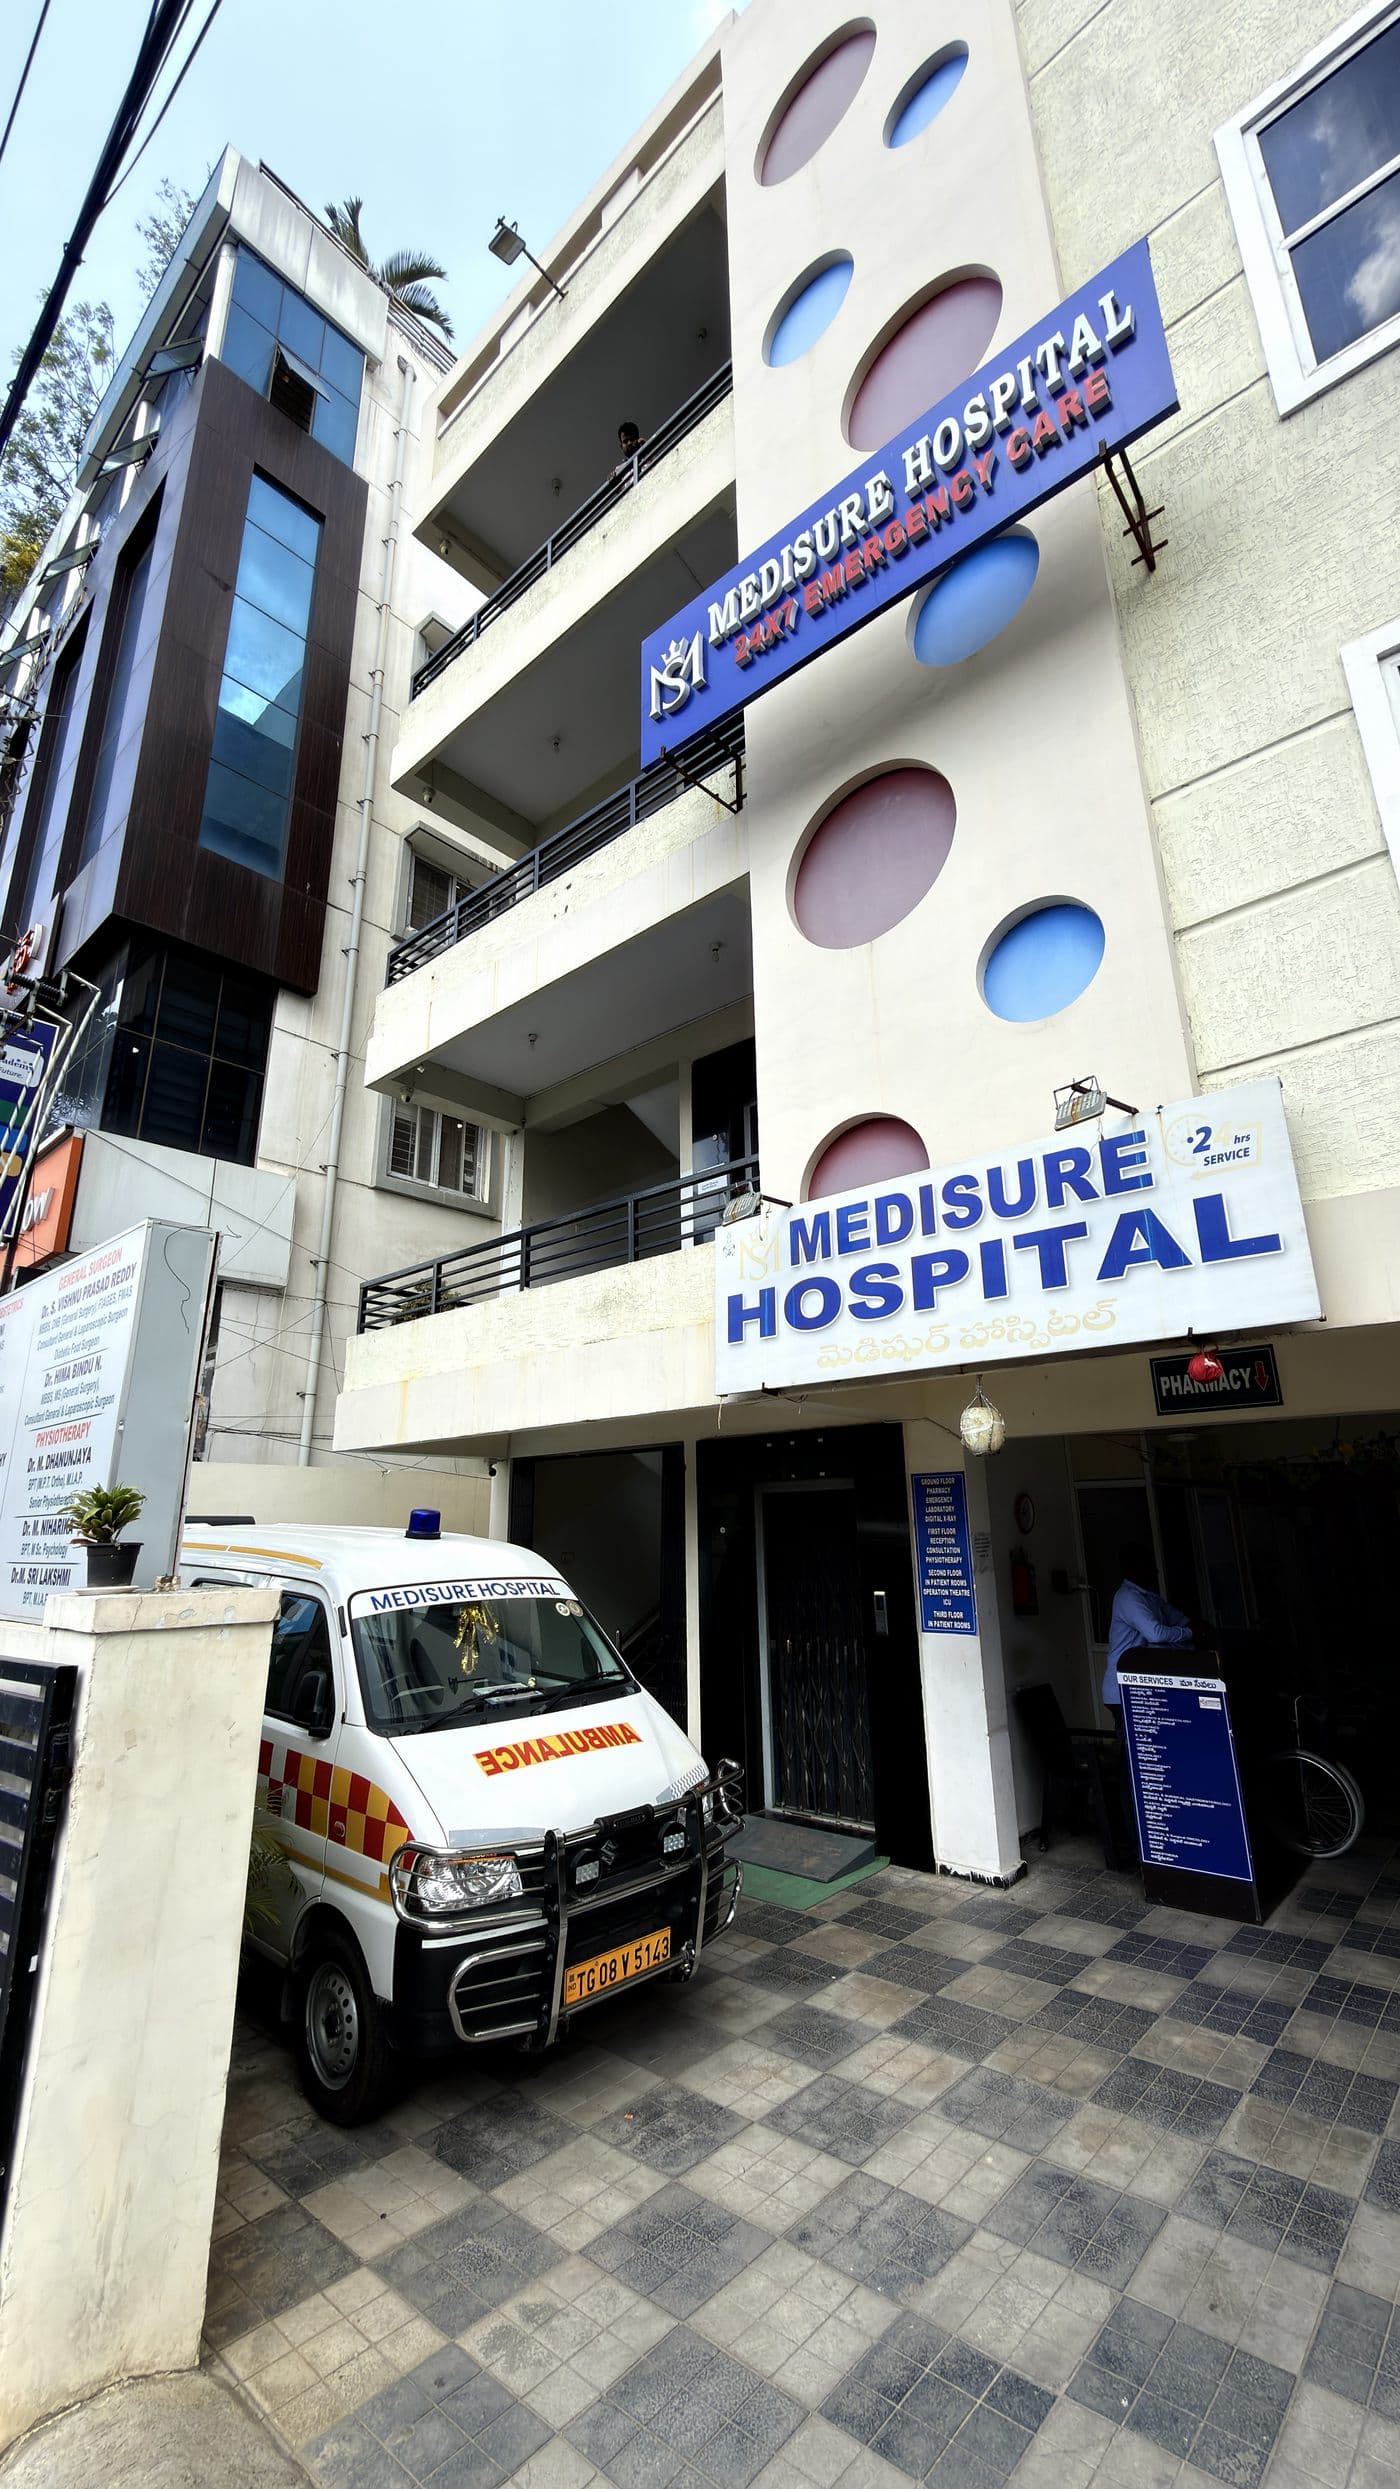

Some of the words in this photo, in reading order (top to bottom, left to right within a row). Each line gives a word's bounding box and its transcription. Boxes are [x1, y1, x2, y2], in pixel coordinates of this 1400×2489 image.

[707, 471, 897, 648] MEDISURE
[902, 288, 1137, 498] HOSPITAL
[732, 598, 803, 670] 24X7
[803, 452, 998, 619] EMERGENCY
[1005, 367, 1114, 473] CARE
[0, 1056, 34, 1077] ademy
[1234, 1133, 1251, 1145] hrs
[1203, 1147, 1250, 1167] SERVICE
[788, 1129, 1154, 1267] MEDISURE
[58, 1265, 88, 1292] GENERAL
[88, 1248, 123, 1278] SURGEON
[727, 1192, 1283, 1344] HOSPITAL
[41, 1305, 50, 1319] Dr.
[58, 1287, 82, 1312] VISHNU
[82, 1274, 109, 1300] PRASAD
[111, 1262, 138, 1288] REDDY
[107, 1307, 129, 1324] Surgeon
[81, 1335, 101, 1353] Surgeon
[44, 1372, 53, 1387] Dr.
[54, 1365, 71, 1384] HIMA
[71, 1358, 95, 1379] BINDU
[94, 1355, 103, 1371] N.
[24, 1408, 45, 1426] Consultant
[45, 1405, 60, 1421] General
[64, 1398, 94, 1418] Laparoscopic
[95, 1393, 116, 1410] Surgeon
[35, 1421, 91, 1449] PHYSIOTHERAPY
[27, 1457, 35, 1473] Dr.
[36, 1454, 44, 1471] M.
[45, 1446, 92, 1470] DHANUNJAYA
[921, 1478, 940, 1486] GROUND
[940, 1477, 956, 1485] FLOOR
[926, 1487, 951, 1495] PHARMACY
[29, 1496, 42, 1509] Senior
[925, 1496, 953, 1504] EMERGENCY
[925, 1505, 955, 1513] LABORATORY
[925, 1515, 943, 1523] DIGITAL
[22, 1520, 31, 1537] Dr.
[32, 1519, 39, 1536] M.
[941, 1527, 957, 1535] FLOOR
[930, 1537, 956, 1545] RECEPTION
[43, 1541, 68, 1559] Psychology
[926, 1546, 961, 1554] CONSULTATION
[925, 1556, 963, 1564] PHYSIOTHERAPY
[26, 1567, 39, 1585] SRI
[39, 1568, 71, 1587] LAKSHMI
[928, 1569, 946, 1577] SECOND
[947, 1569, 963, 1577] FLOOR
[370, 1584, 478, 1611] MEDISURE
[478, 1582, 561, 1598] HOSPITAL
[923, 1588, 949, 1596] OPERATION
[950, 1589, 971, 1597] THEATRE
[943, 1598, 952, 1606] ICU
[933, 1610, 948, 1618] THIRD
[948, 1611, 964, 1619] FLOOR
[953, 1622, 971, 1630] ROOMS
[1122, 1674, 1138, 1684] OUR
[1138, 1676, 1174, 1686] SERVICES
[577, 1967, 596, 1997] TG
[599, 1958, 617, 1986] 08
[621, 1951, 630, 1976] V
[634, 1936, 670, 1971] 5143
